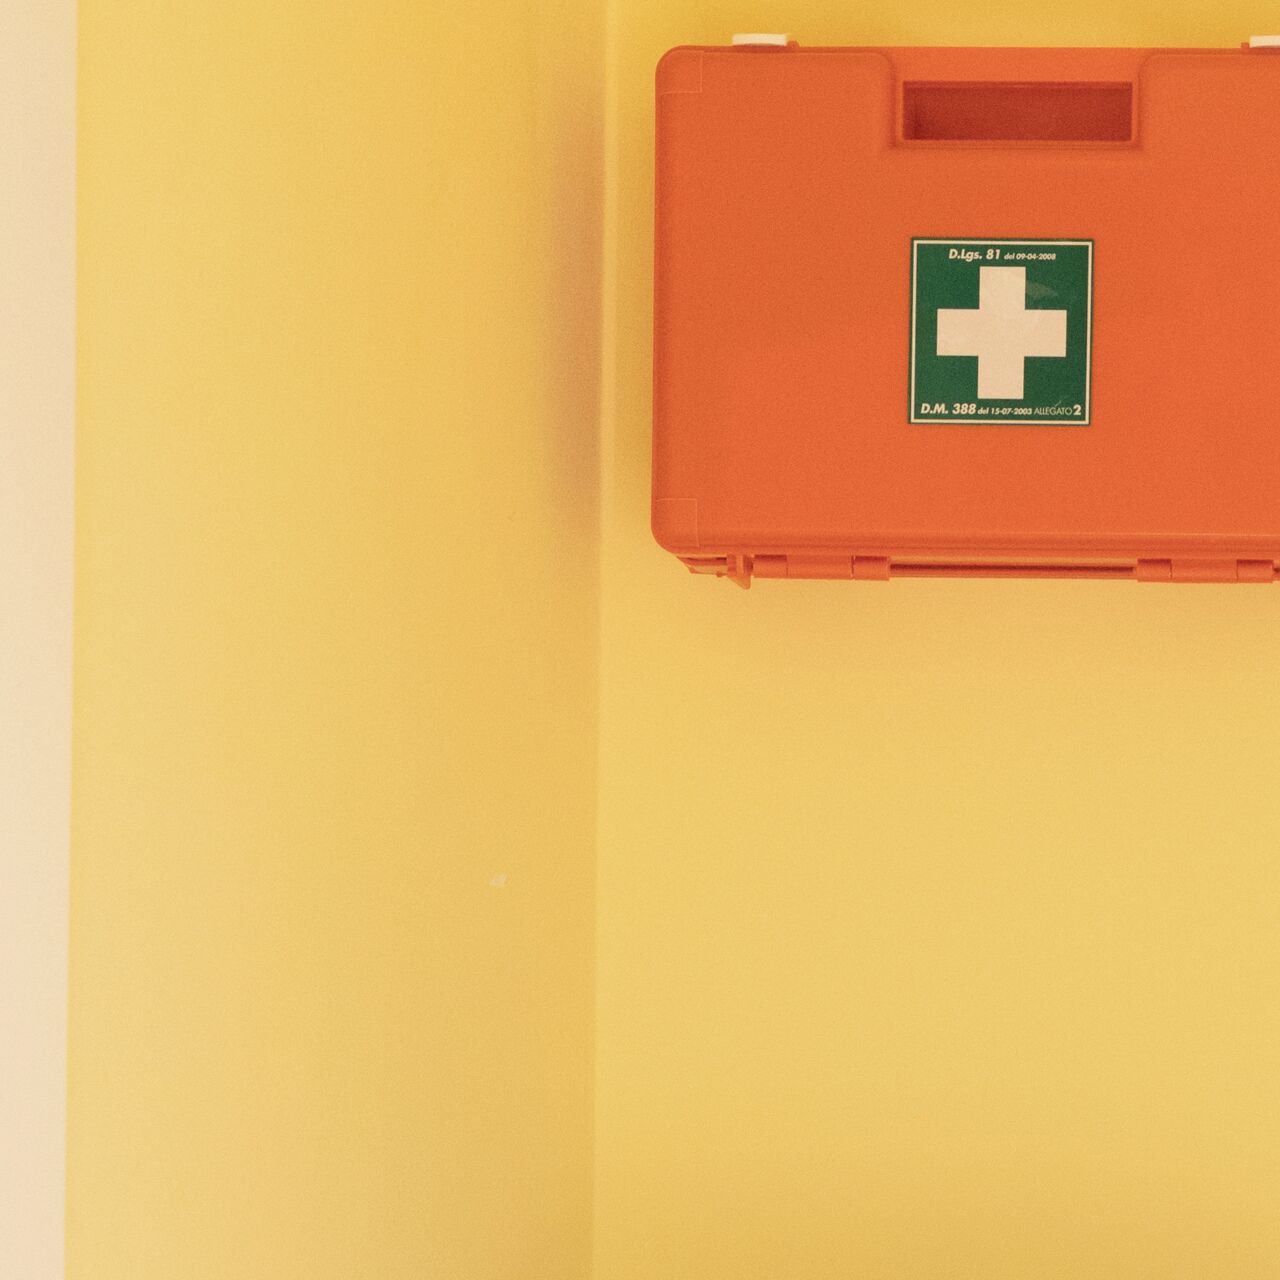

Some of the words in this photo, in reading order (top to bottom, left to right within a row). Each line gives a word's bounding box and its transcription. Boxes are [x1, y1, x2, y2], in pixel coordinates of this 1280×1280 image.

[949, 249, 982, 262] D.Lgs.
[986, 249, 1000, 260] 81
[1004, 252, 1015, 260] del
[1016, 253, 1056, 261] 09-04-2008
[921, 403, 948, 414] D.M.
[952, 404, 976, 415] 388
[978, 407, 989, 415] del
[1034, 407, 1072, 416] ALLEGATO
[1073, 404, 1082, 416] 2
